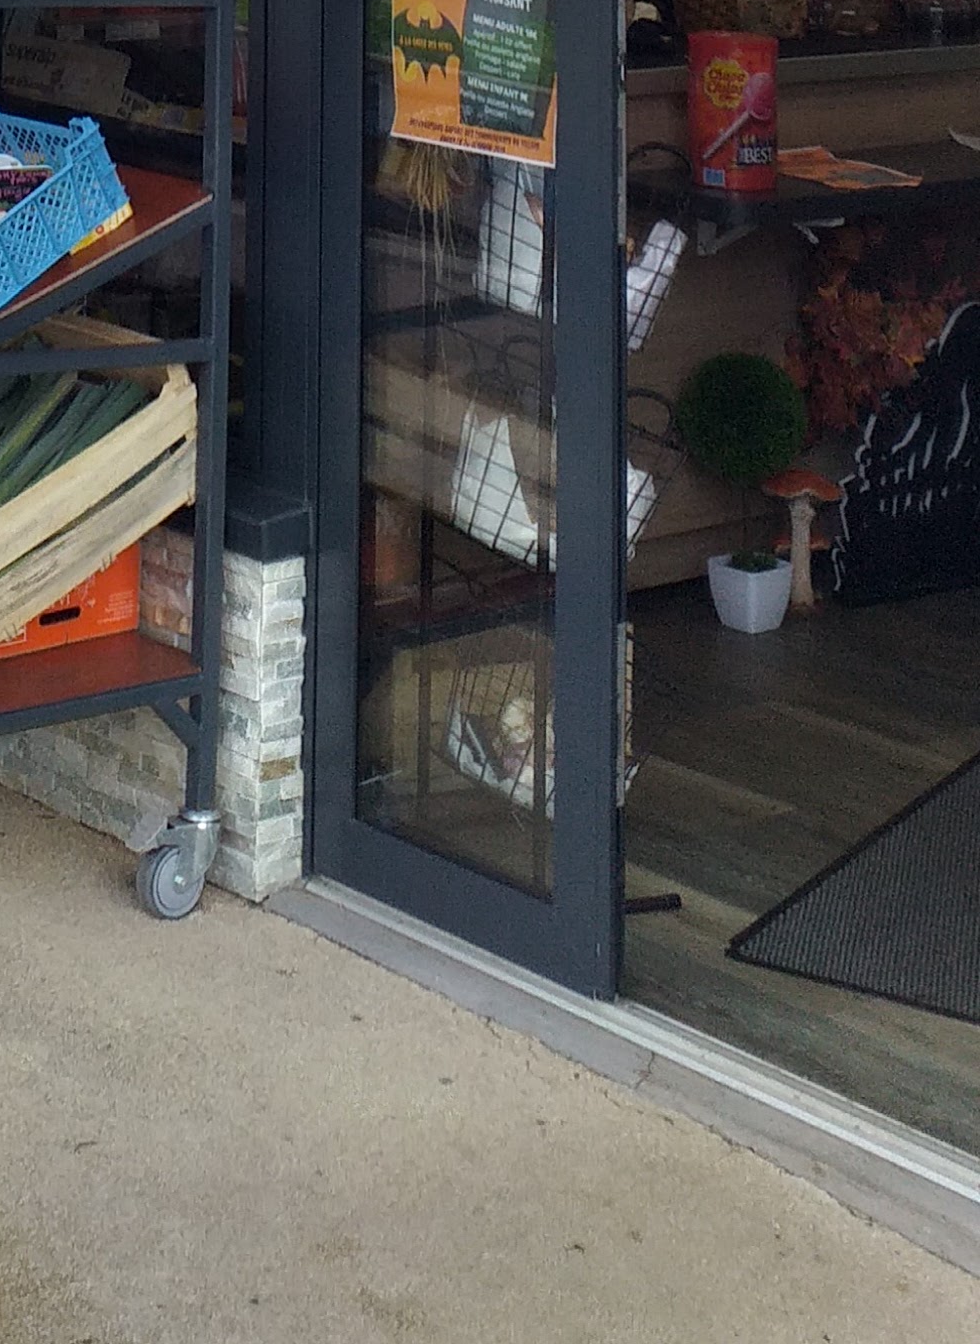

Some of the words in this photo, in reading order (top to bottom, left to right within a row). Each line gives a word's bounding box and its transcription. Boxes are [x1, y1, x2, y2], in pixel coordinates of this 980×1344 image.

[472, 12, 495, 28] MENU
[495, 19, 524, 38] ADULTE
[467, 75, 489, 92] MENU
[490, 82, 519, 100] ENFANT
